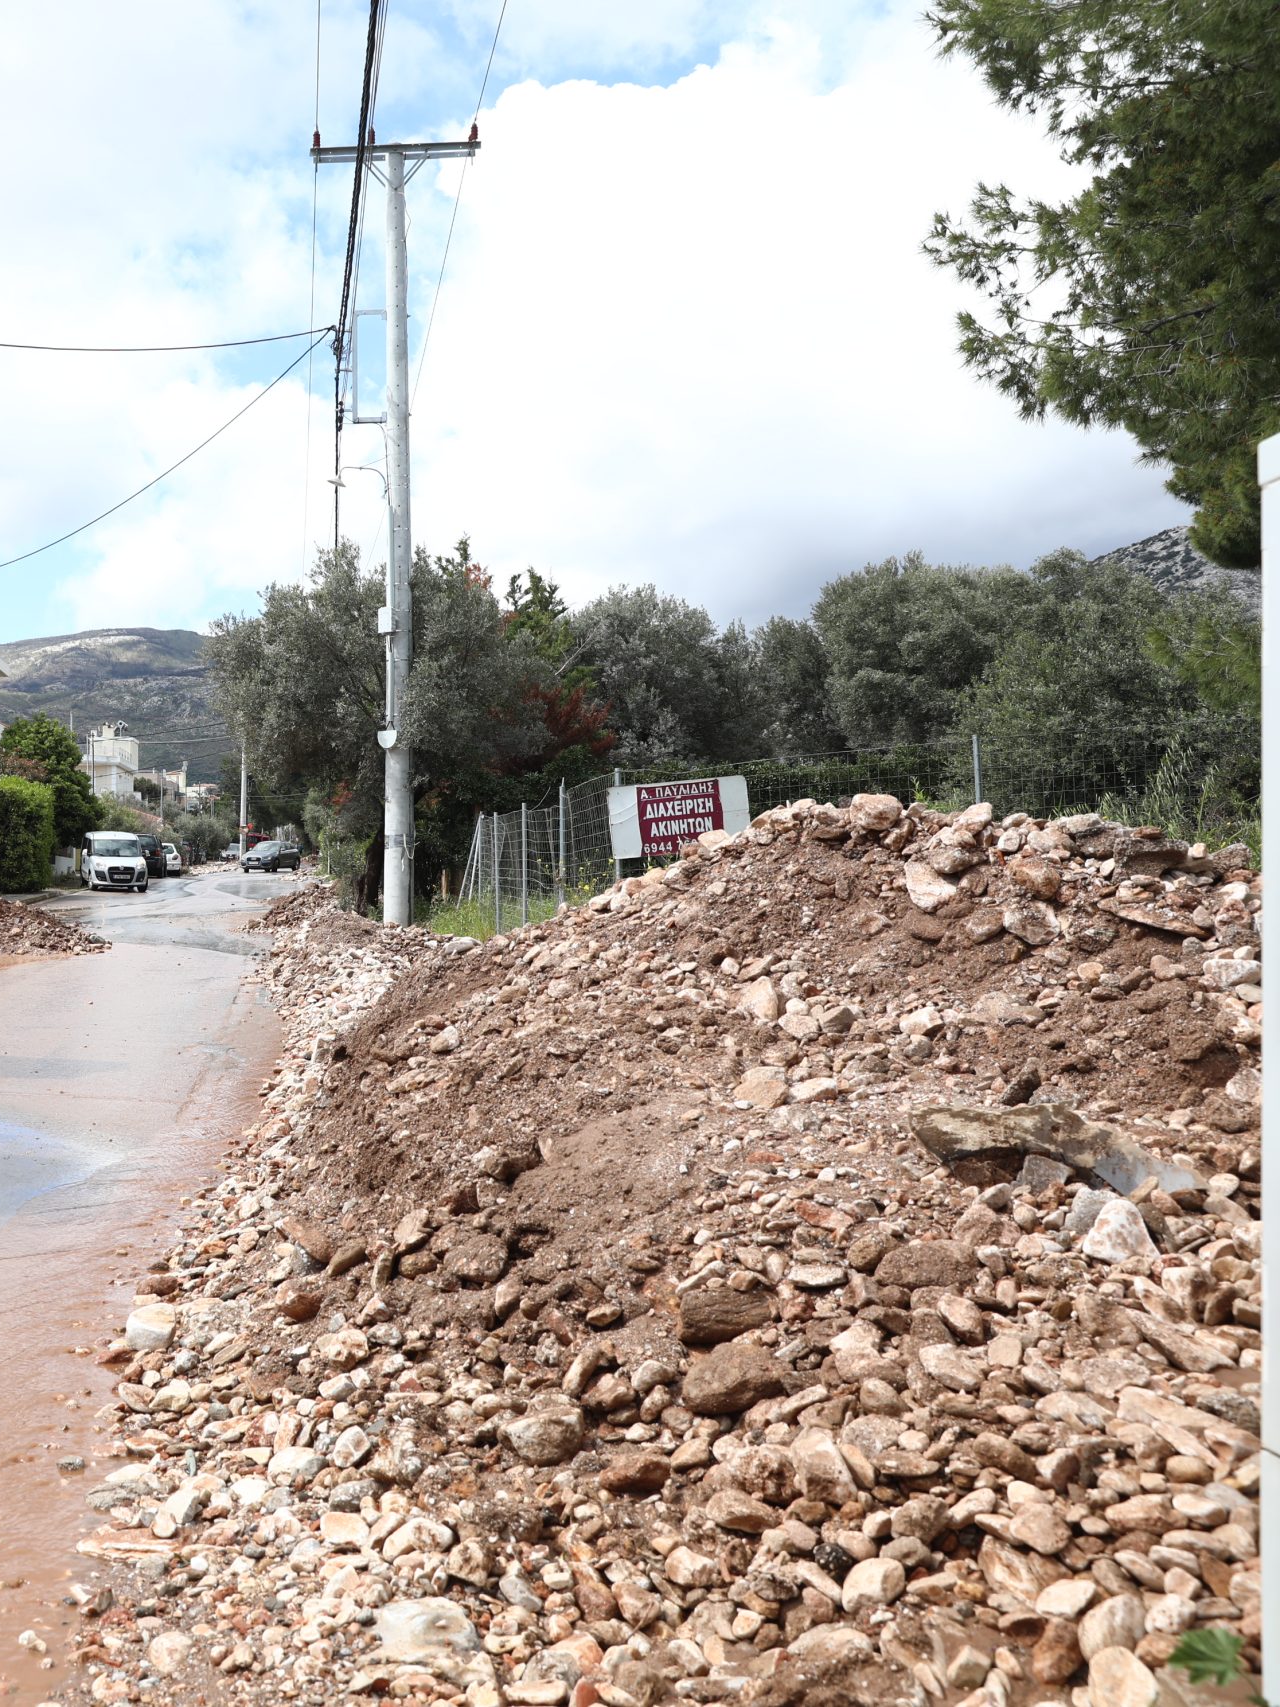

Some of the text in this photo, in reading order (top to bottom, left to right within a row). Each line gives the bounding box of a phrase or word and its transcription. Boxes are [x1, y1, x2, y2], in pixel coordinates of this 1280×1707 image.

[640, 781, 715, 799] Α. ΠΑΥΛΙΔΗΣ
[646, 797, 714, 819] ΔΙΑΧΕΙΡΙΣΗ
[650, 816, 713, 838] ΑΚΙΝΗΤΩΝ
[643, 841, 673, 854] 6944
